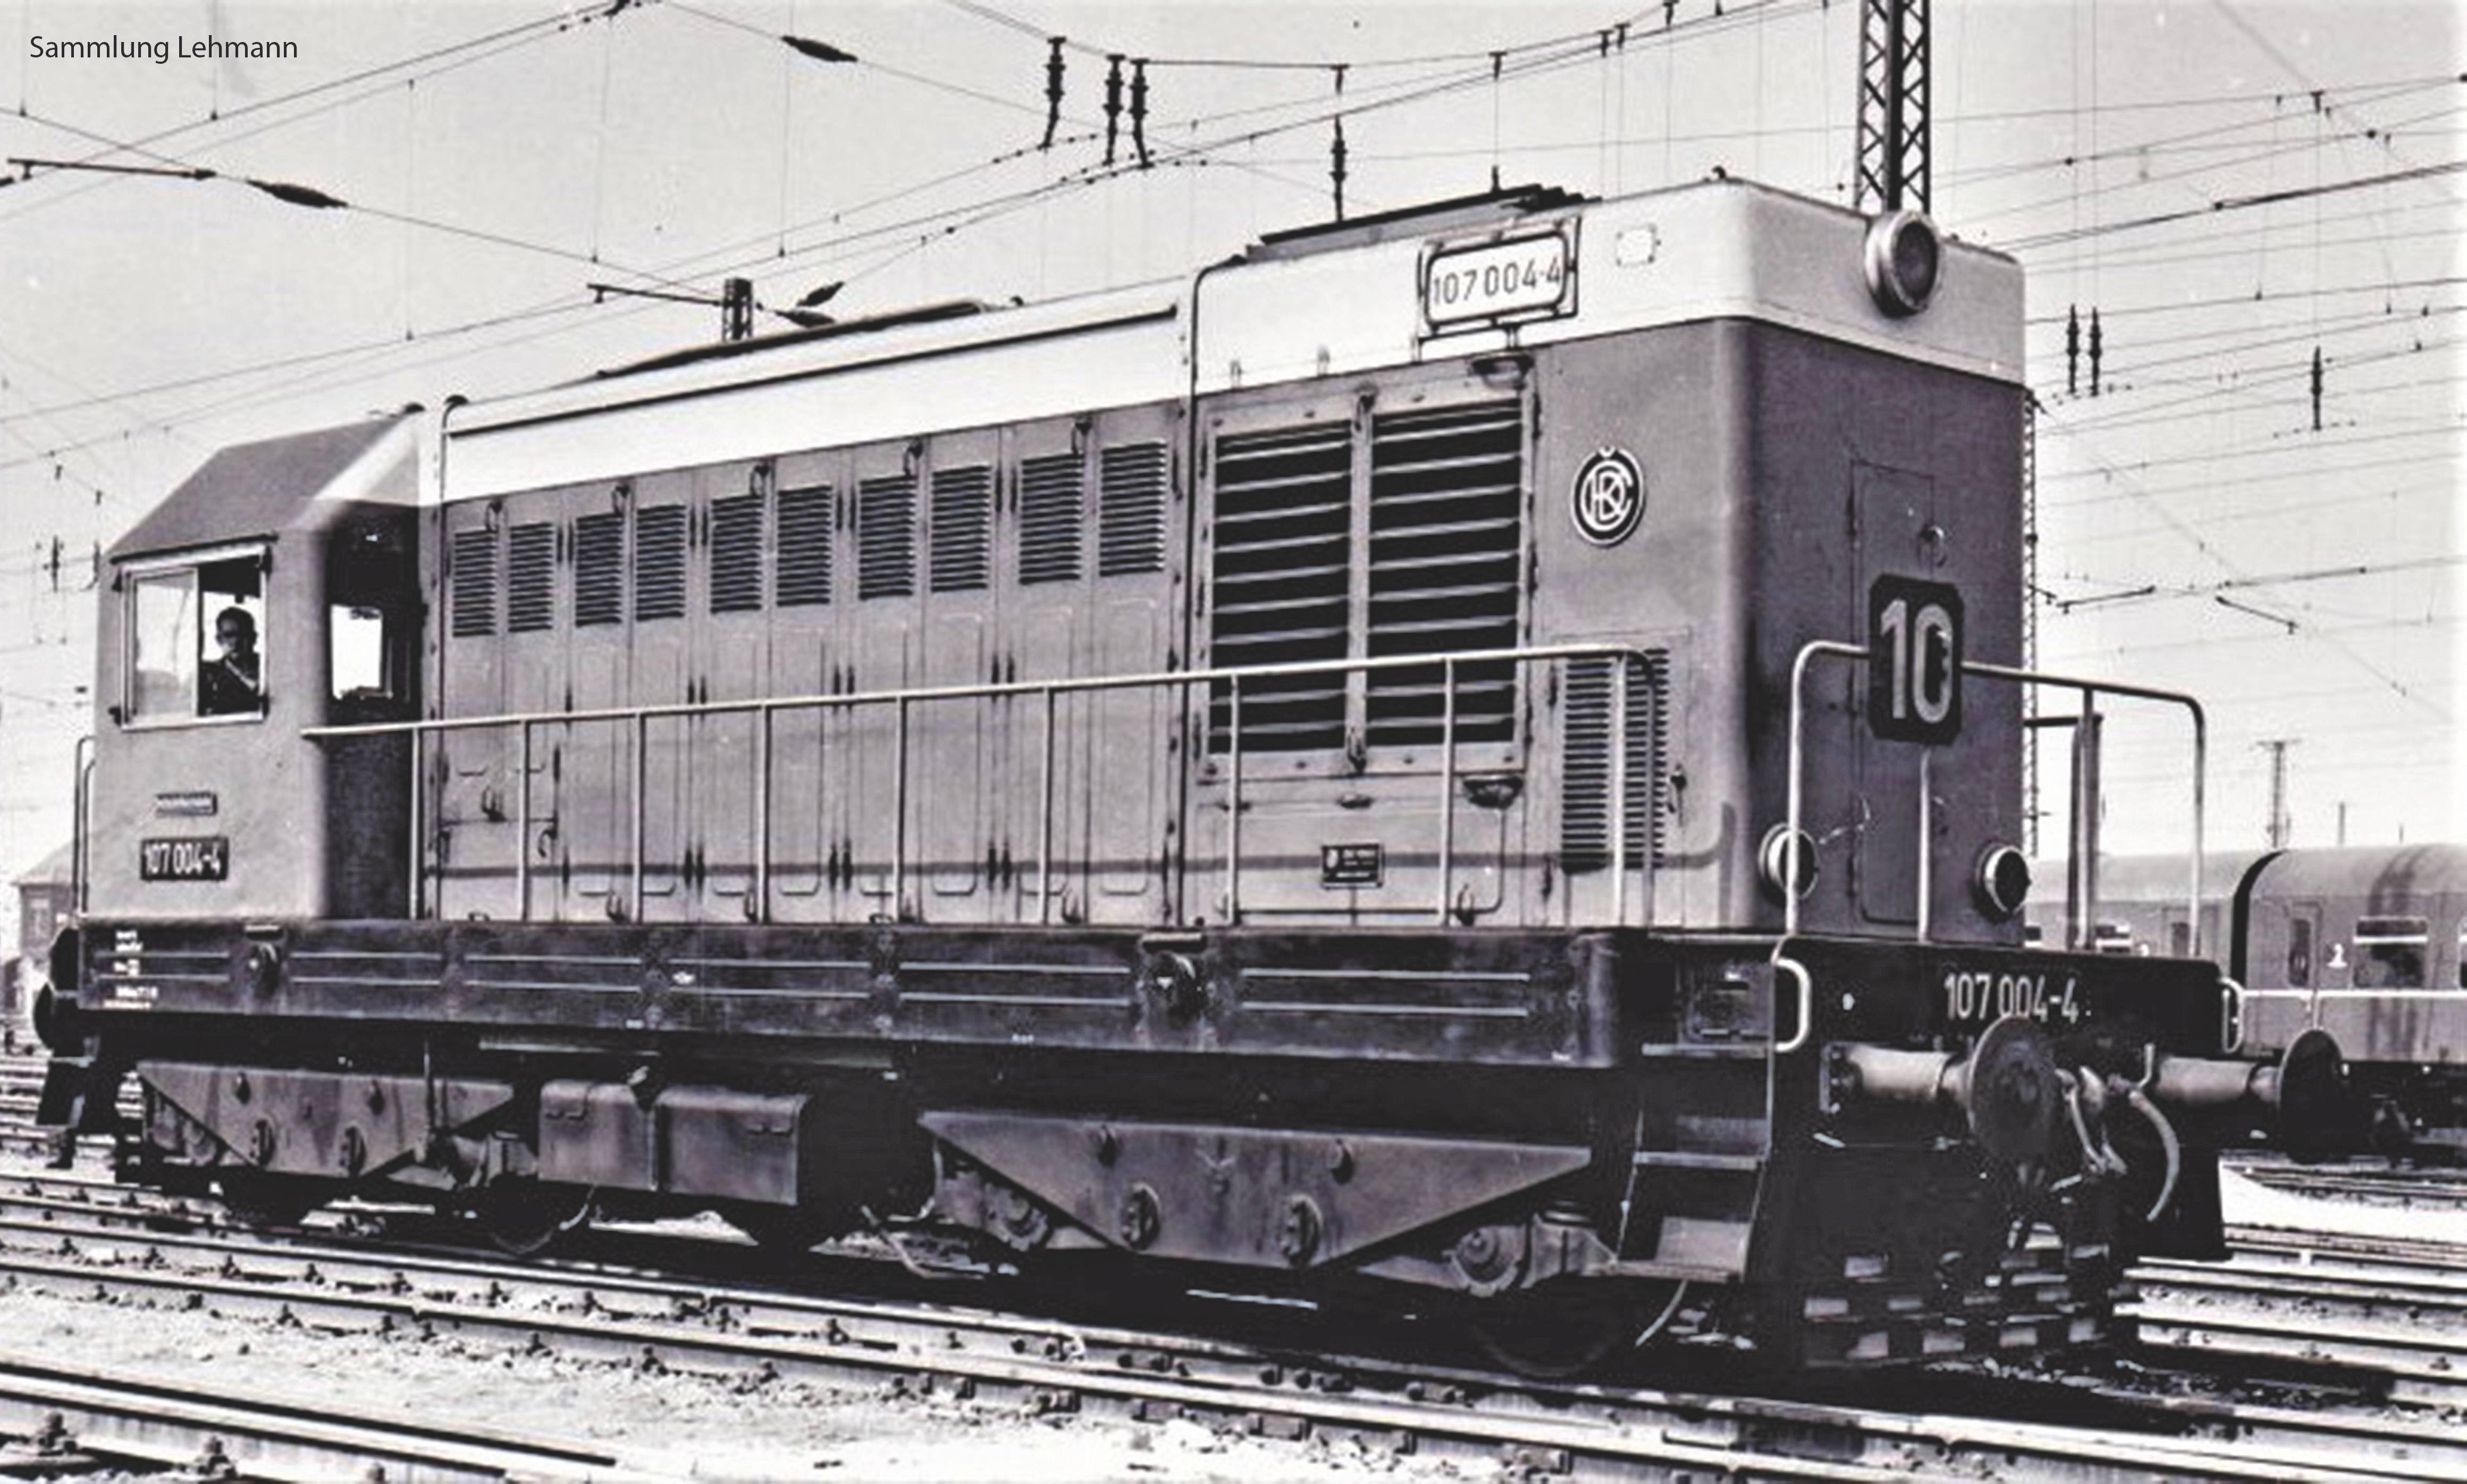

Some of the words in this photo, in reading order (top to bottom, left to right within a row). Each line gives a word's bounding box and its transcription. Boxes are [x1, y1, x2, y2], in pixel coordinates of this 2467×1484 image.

[1433, 268, 1478, 305] 107
[1880, 598, 1954, 724] 10
[1943, 972, 1992, 1020] 107
[1997, 974, 2079, 1024] 004-4
